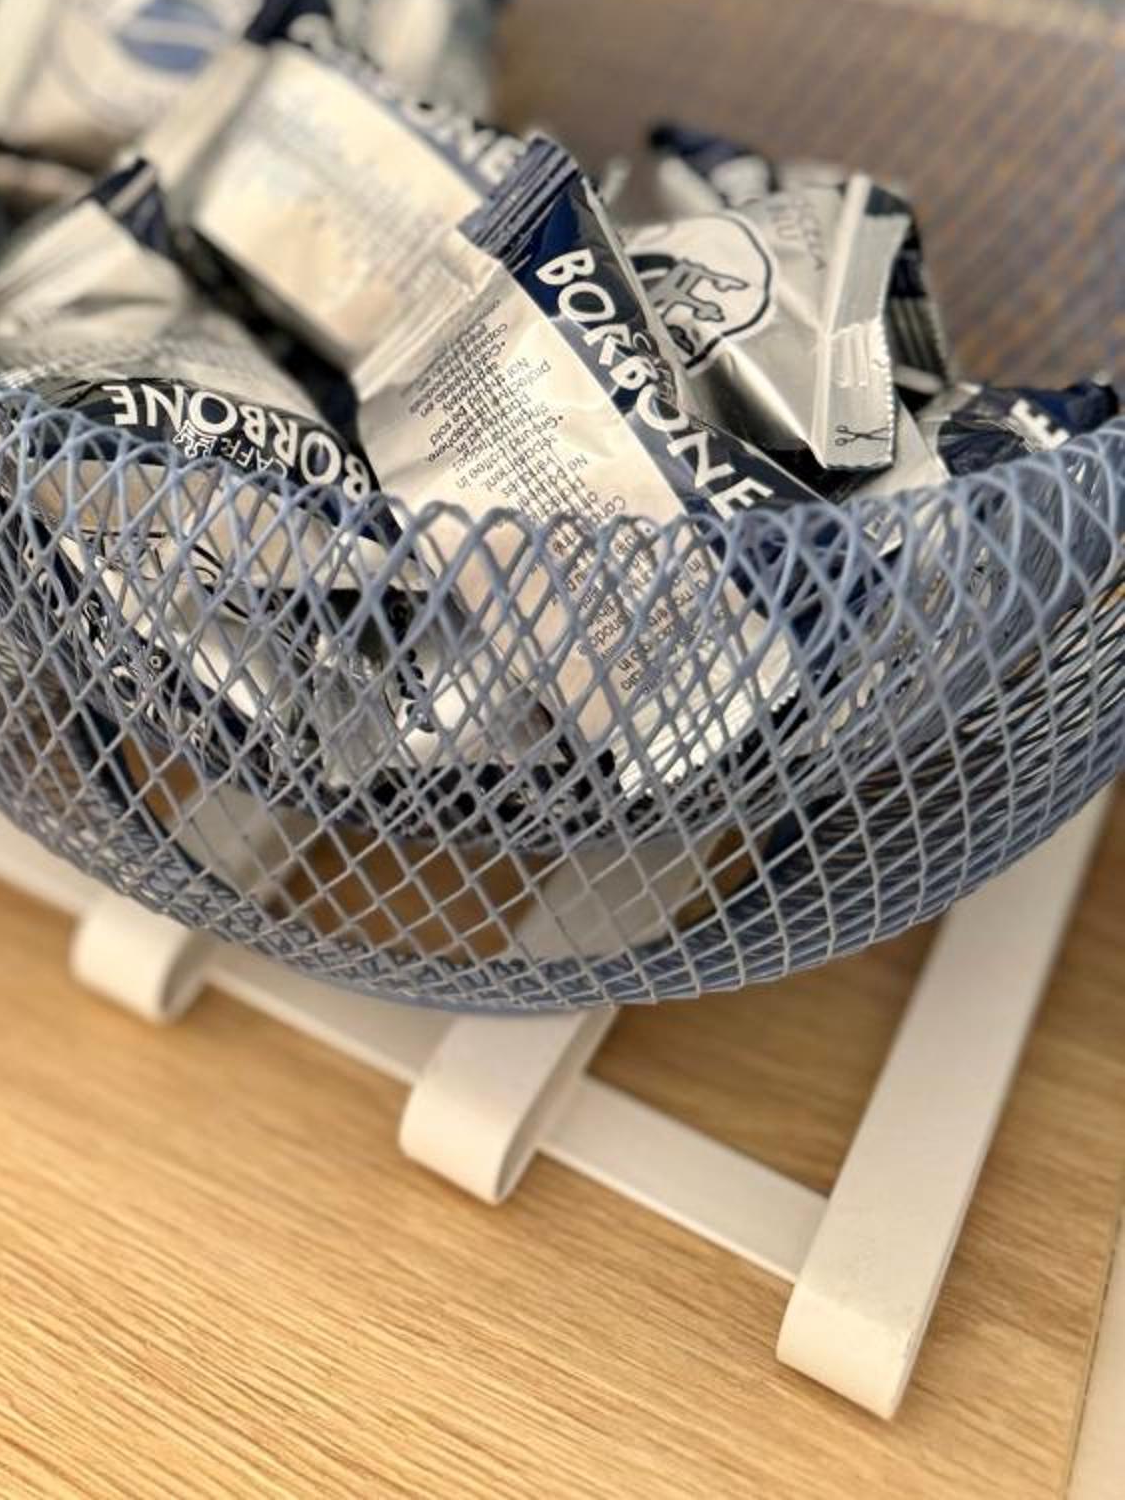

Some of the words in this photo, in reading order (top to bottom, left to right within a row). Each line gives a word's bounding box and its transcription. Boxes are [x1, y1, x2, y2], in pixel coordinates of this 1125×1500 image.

[535, 248, 774, 521] BORBONE
[449, 404, 468, 425] be
[100, 383, 368, 502] BORBONE
[427, 420, 453, 446] sold
[454, 441, 469, 455] in
[467, 446, 508, 480] coffee
[453, 475, 471, 491] in
